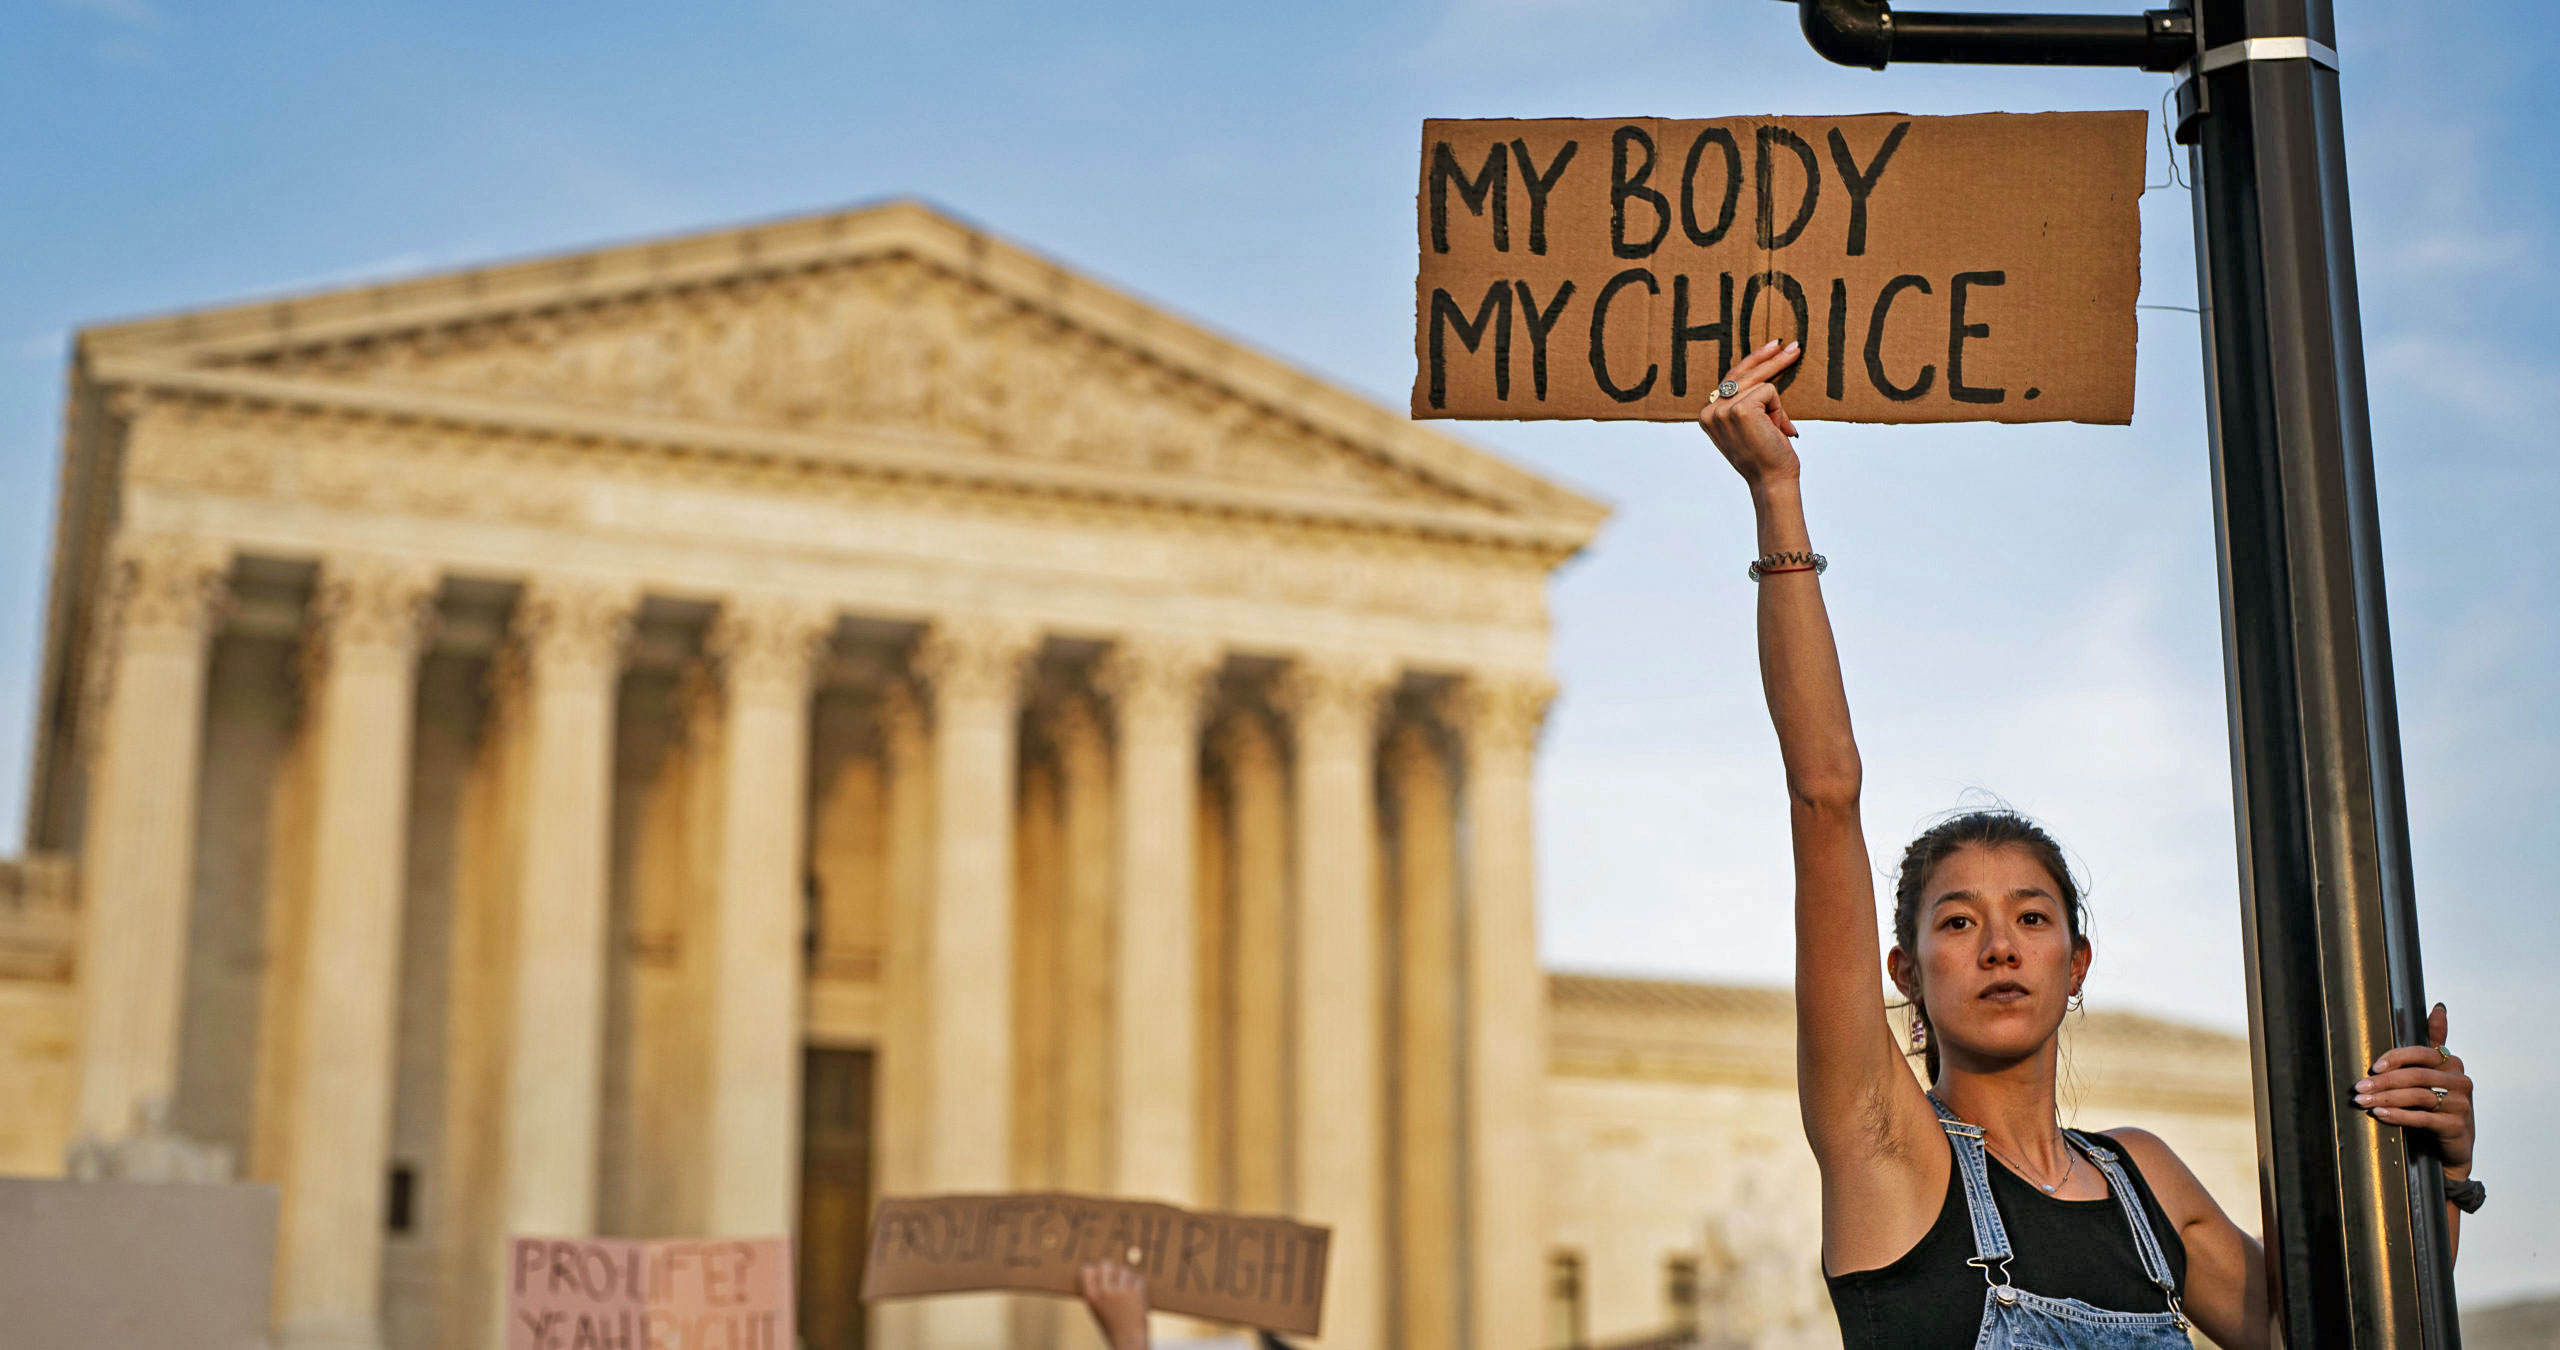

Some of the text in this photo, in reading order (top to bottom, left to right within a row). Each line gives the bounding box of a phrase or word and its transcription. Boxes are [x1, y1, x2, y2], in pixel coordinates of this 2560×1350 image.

[1428, 121, 1911, 260] MY BODY
[1428, 266, 2041, 410] MY CHOICE.
[1175, 1215, 1327, 1308] RIGHT
